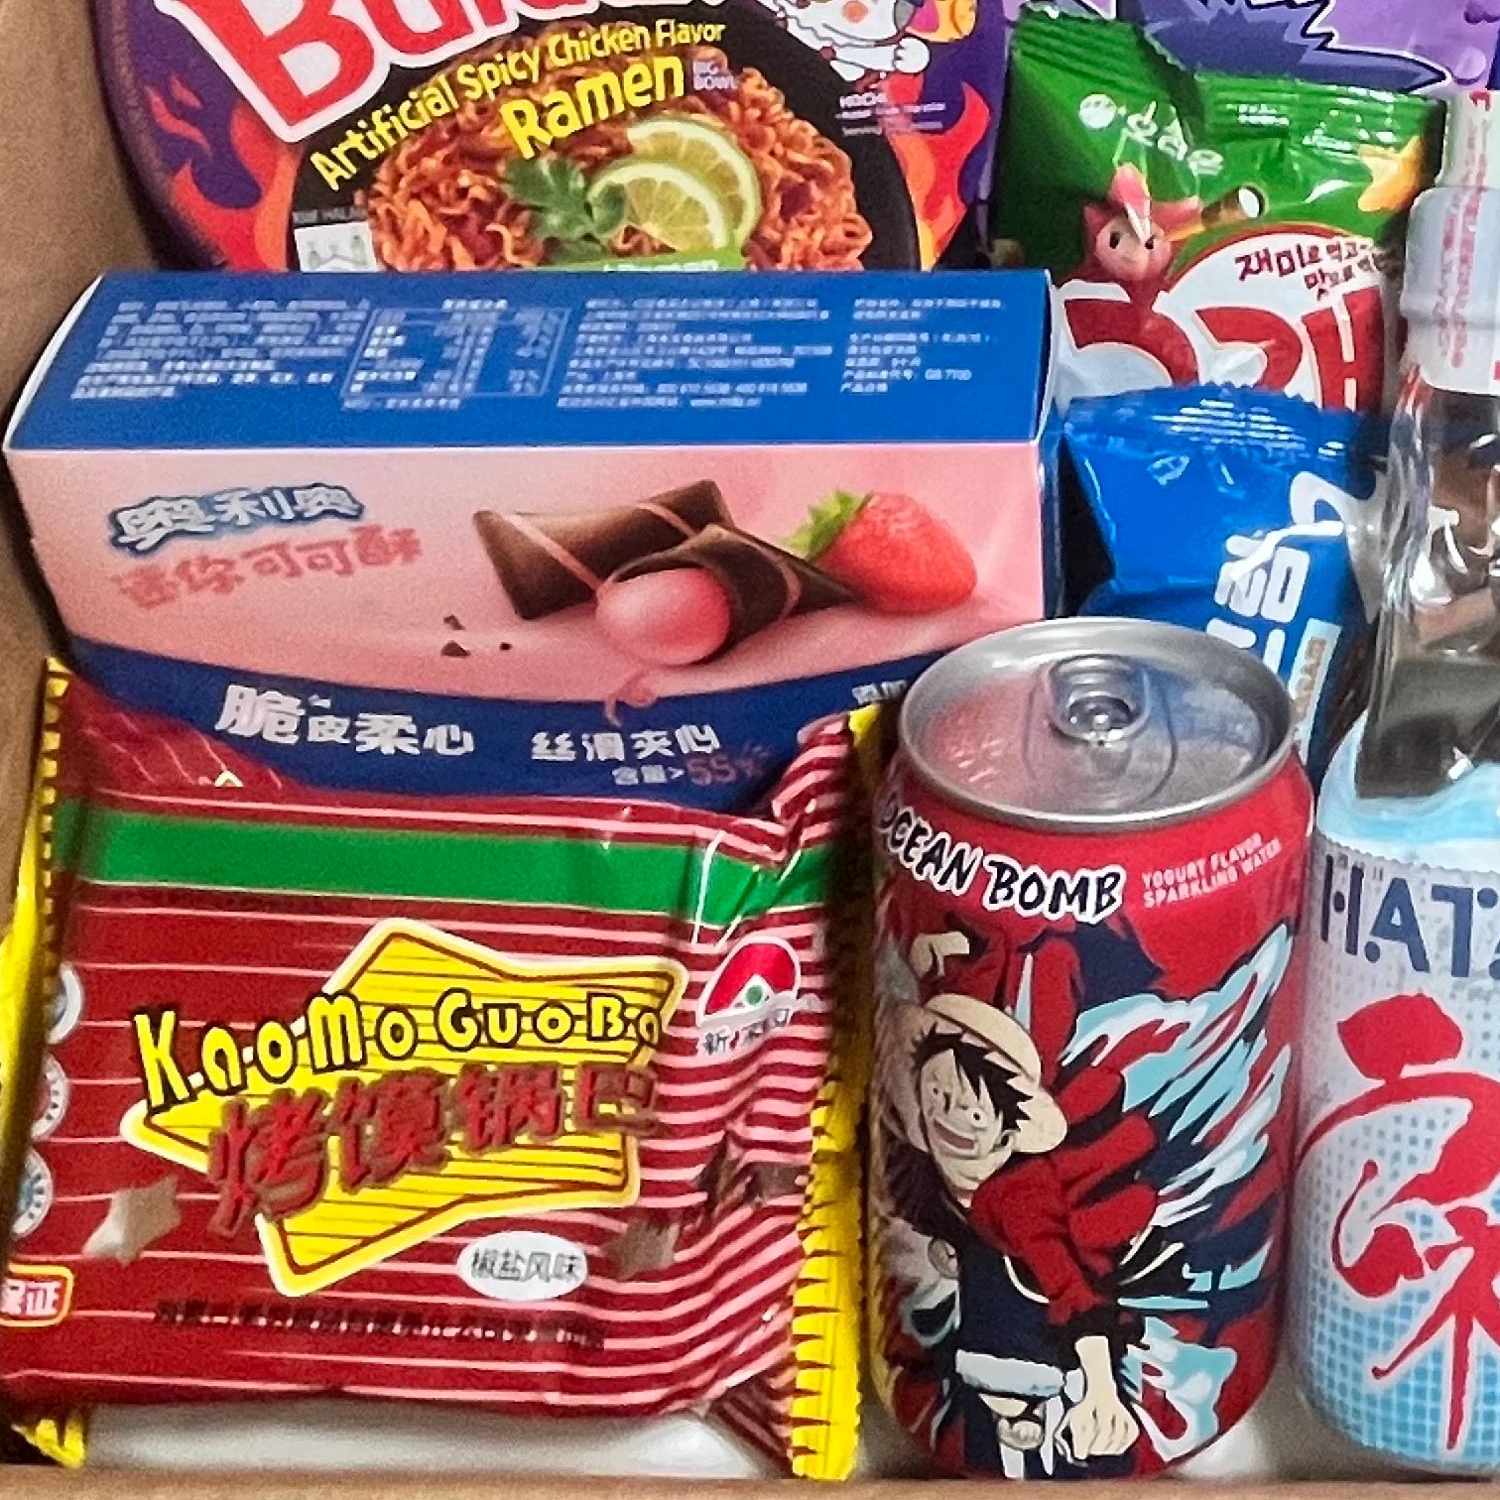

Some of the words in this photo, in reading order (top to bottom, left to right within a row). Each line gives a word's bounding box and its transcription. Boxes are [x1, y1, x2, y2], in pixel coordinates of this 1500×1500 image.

[310, 85, 457, 190] Artificial
[457, 49, 541, 100] Spicy
[547, 22, 651, 71] Chicken
[655, 19, 727, 52] Flavor
[501, 57, 684, 159] Ramen
[216, 683, 476, 758] 脆皮柔心
[983, 854, 1126, 924] BOMB
[1141, 857, 1207, 890] YOGURT
[1210, 831, 1262, 872] FLAVOR
[1143, 864, 1239, 909] SPARKLING
